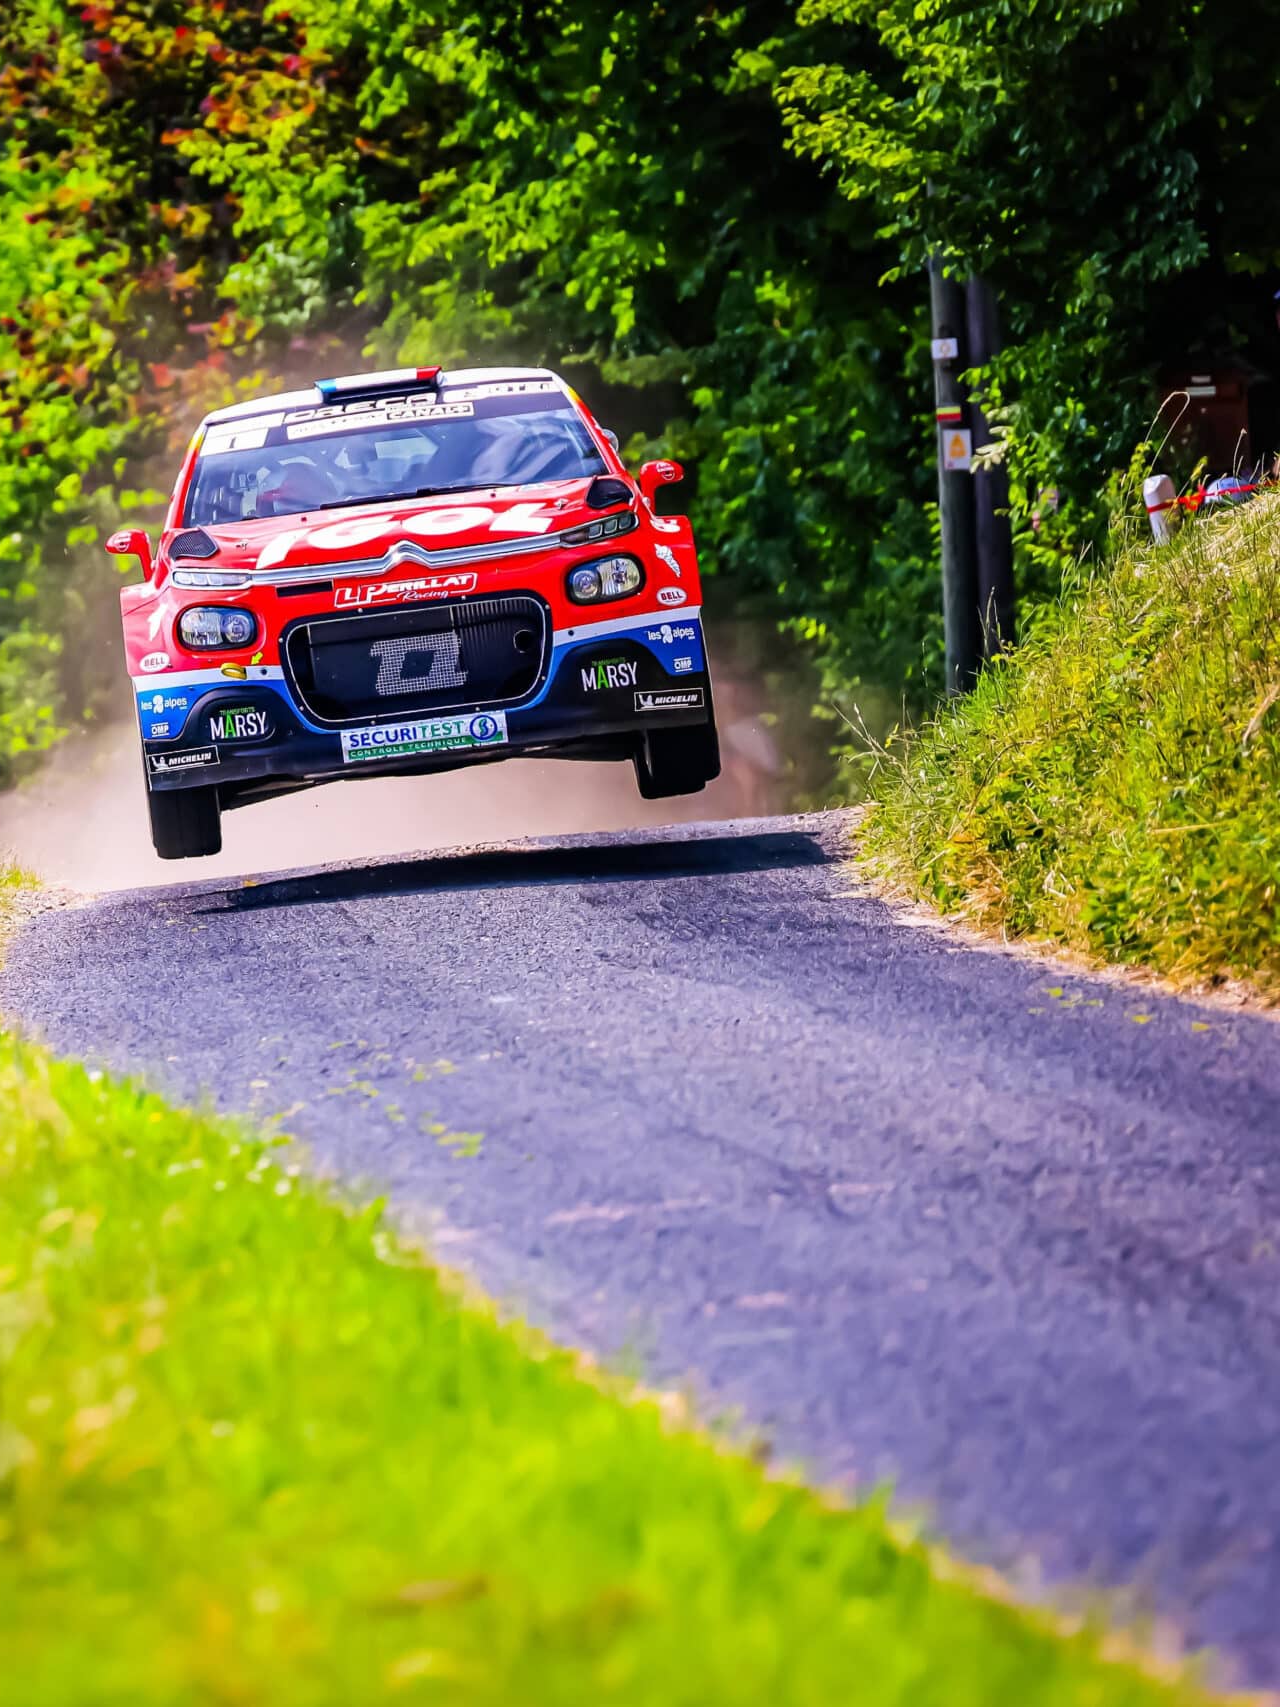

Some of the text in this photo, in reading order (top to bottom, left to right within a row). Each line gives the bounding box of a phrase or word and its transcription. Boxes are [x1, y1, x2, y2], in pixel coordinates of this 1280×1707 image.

[256, 502, 555, 569] IGOL
[396, 589, 450, 601] Racing
[660, 592, 683, 601] BELL
[143, 656, 166, 667] BELL
[581, 661, 637, 692] MARSY
[655, 694, 698, 705] MICHELIN
[151, 724, 169, 735] OMP
[210, 711, 266, 741] MARSY
[349, 720, 465, 747] SECURITEST
[408, 738, 467, 750] TECHNIQUE
[168, 752, 212, 765] MICHELIN
